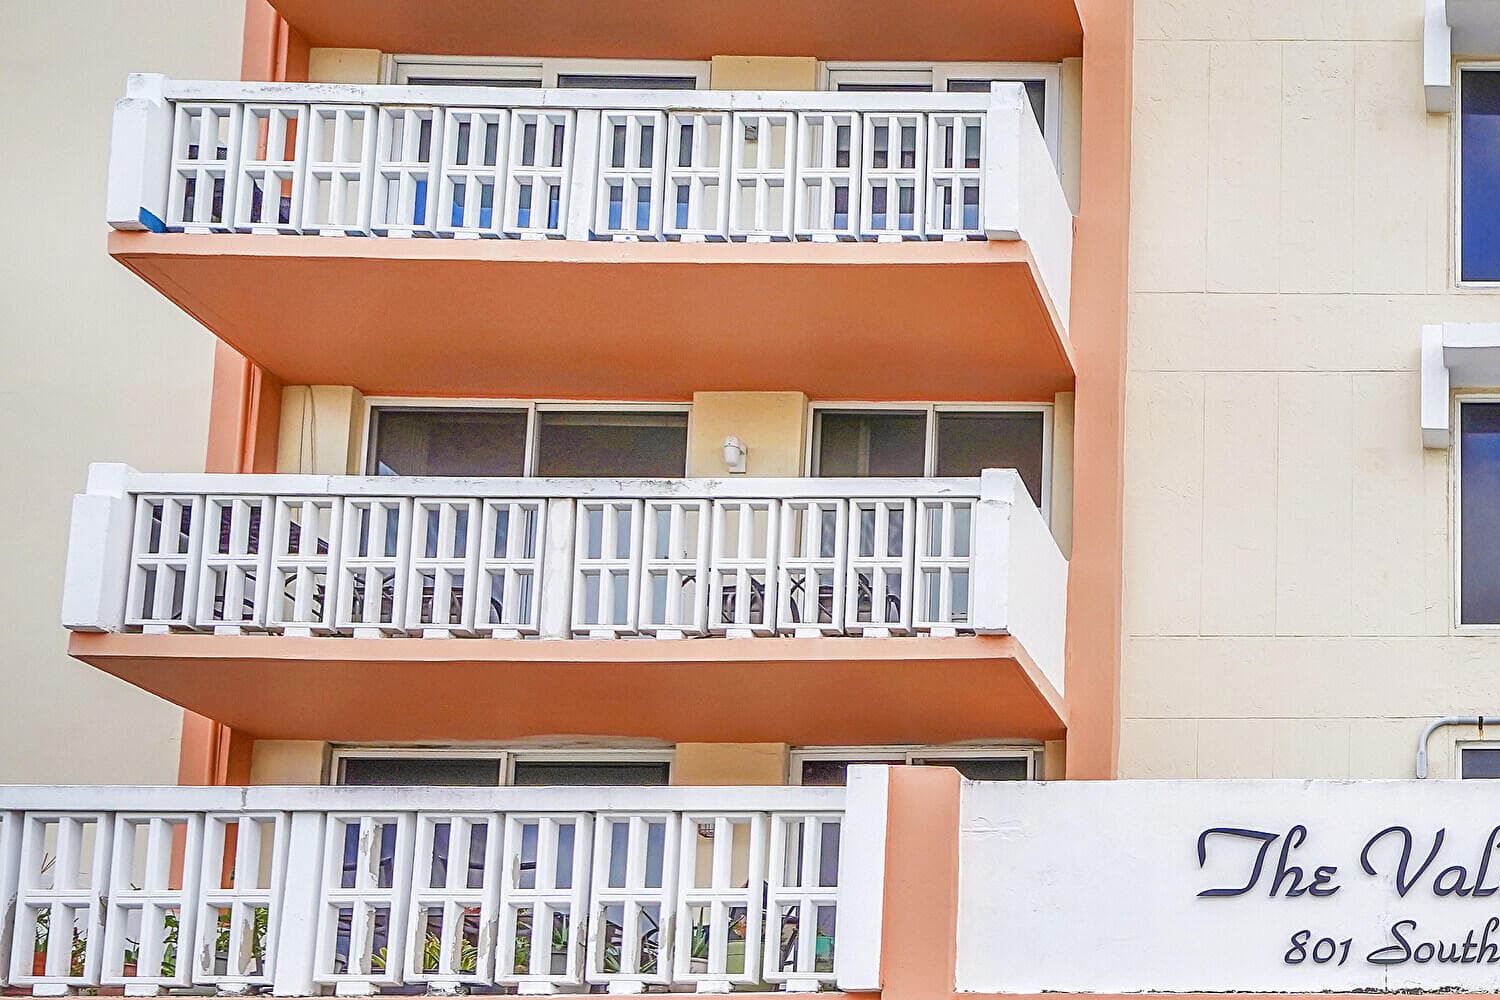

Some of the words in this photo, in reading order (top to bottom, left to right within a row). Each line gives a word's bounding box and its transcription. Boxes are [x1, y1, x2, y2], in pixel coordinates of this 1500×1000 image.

[1197, 825, 1341, 898] The
[1284, 929, 1353, 966] 801
[1367, 918, 1500, 965] South
